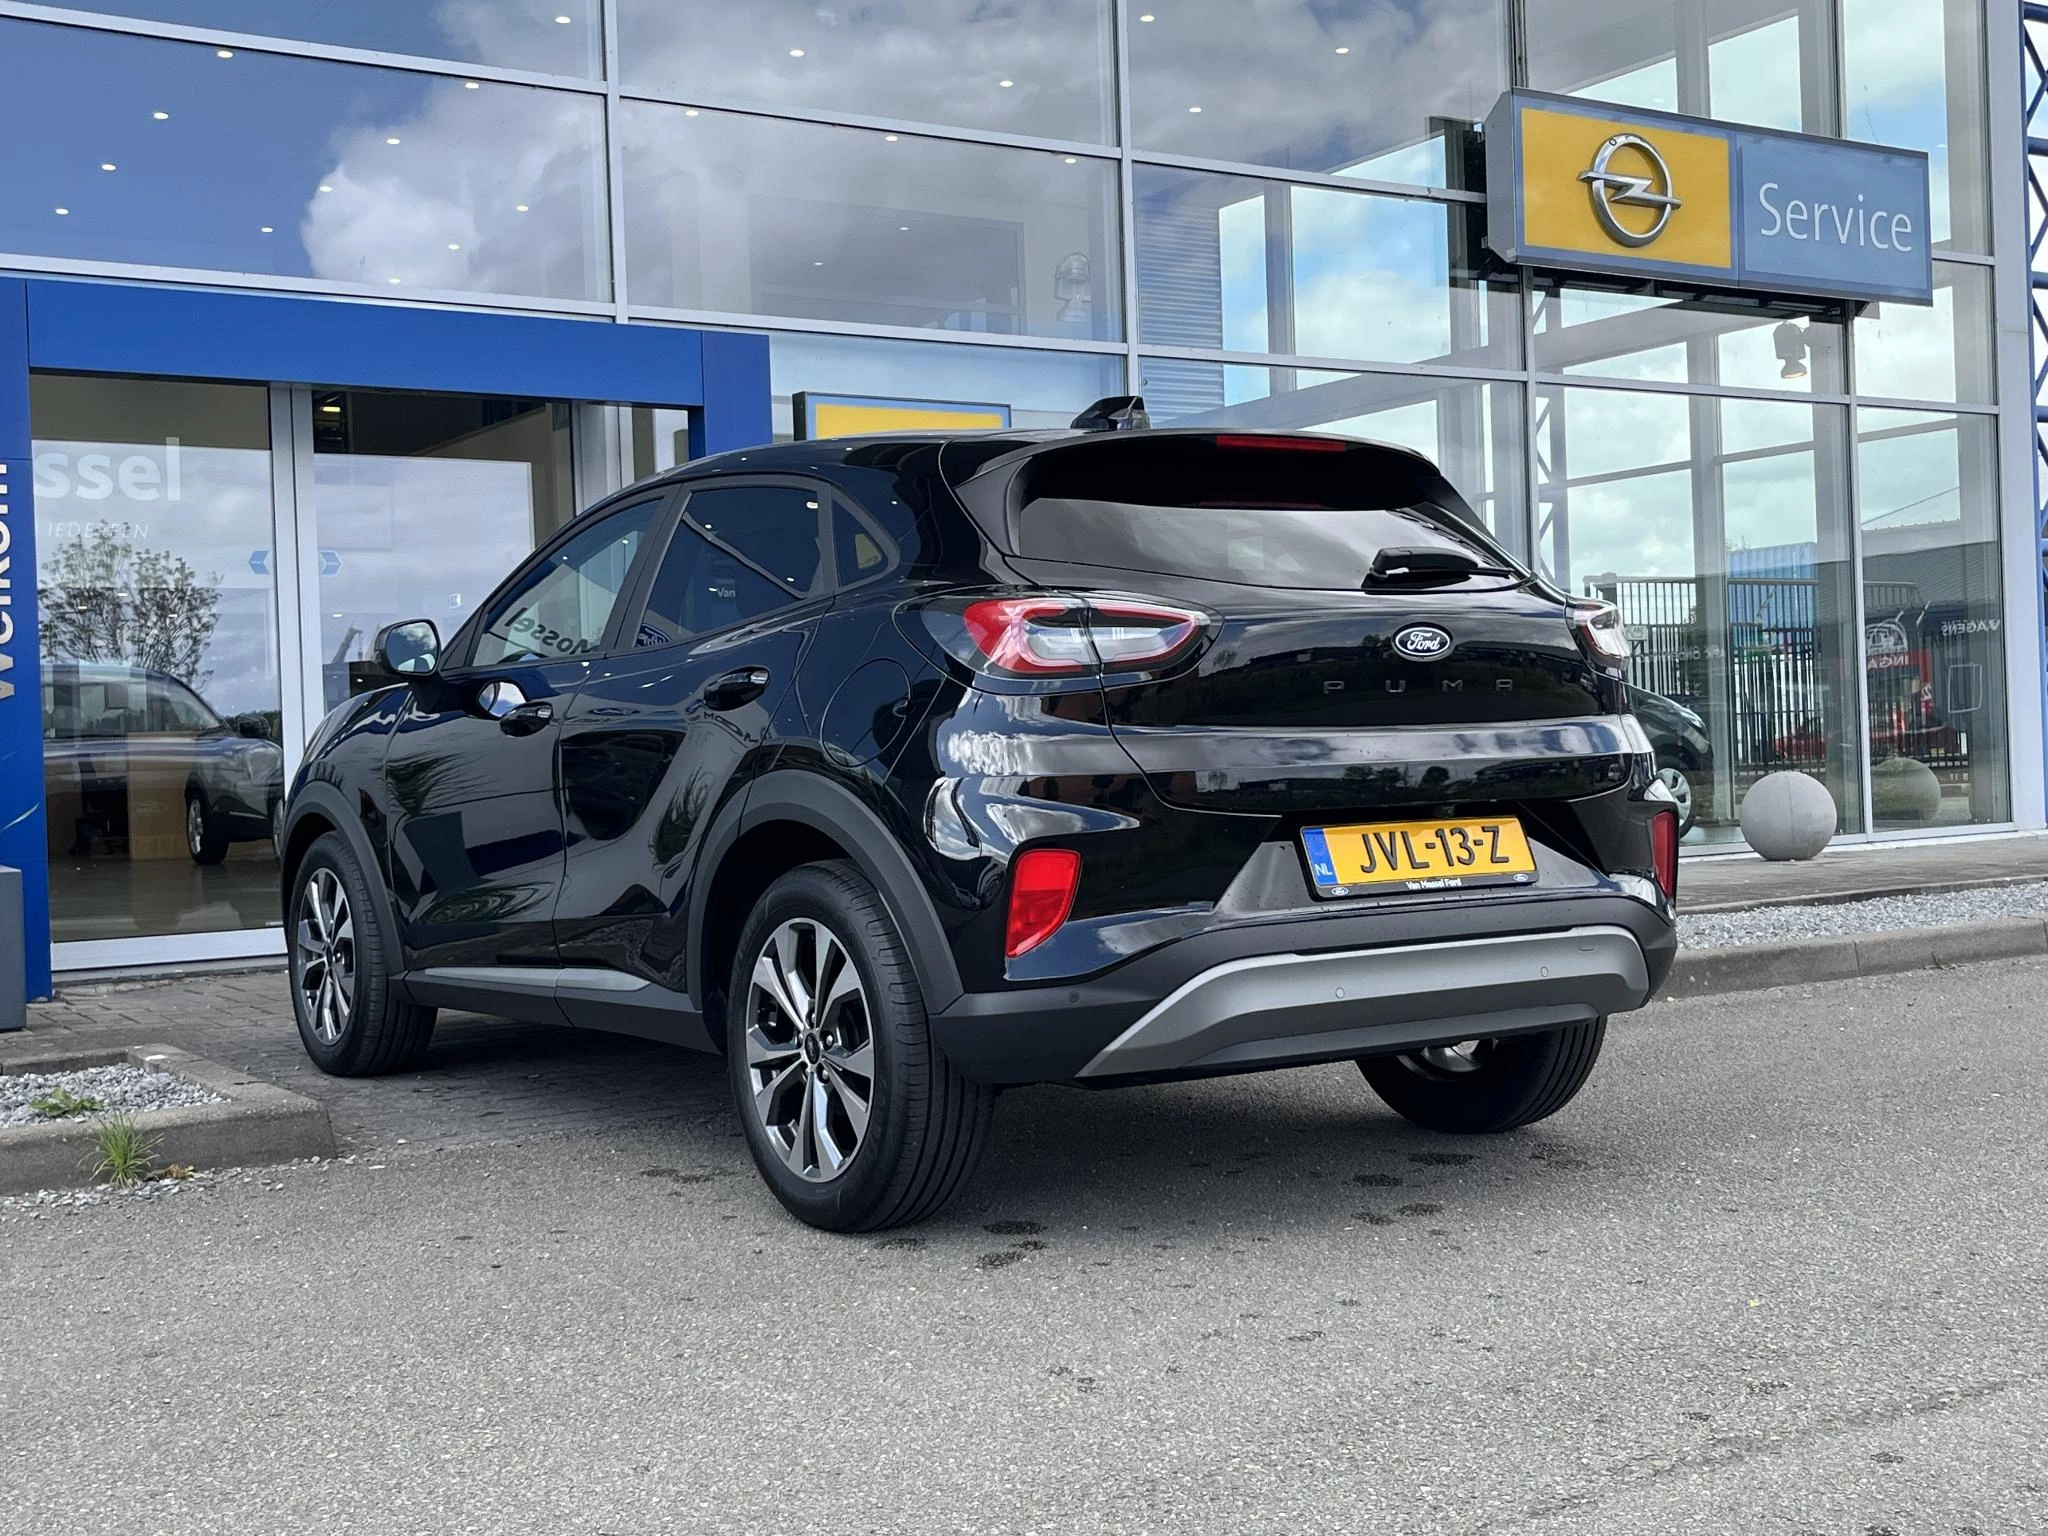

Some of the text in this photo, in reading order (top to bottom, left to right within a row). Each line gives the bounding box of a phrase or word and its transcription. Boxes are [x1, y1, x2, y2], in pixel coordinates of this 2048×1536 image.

[1759, 182, 1912, 252] Service
[717, 587, 736, 598] Van
[1406, 631, 1441, 650] Ford
[1323, 678, 1513, 694] PUMA
[1360, 825, 1510, 873] JVL-13-Z
[1314, 863, 1334, 877] NL
[1405, 881, 1421, 890] Van
[1445, 877, 1463, 887] Ford
